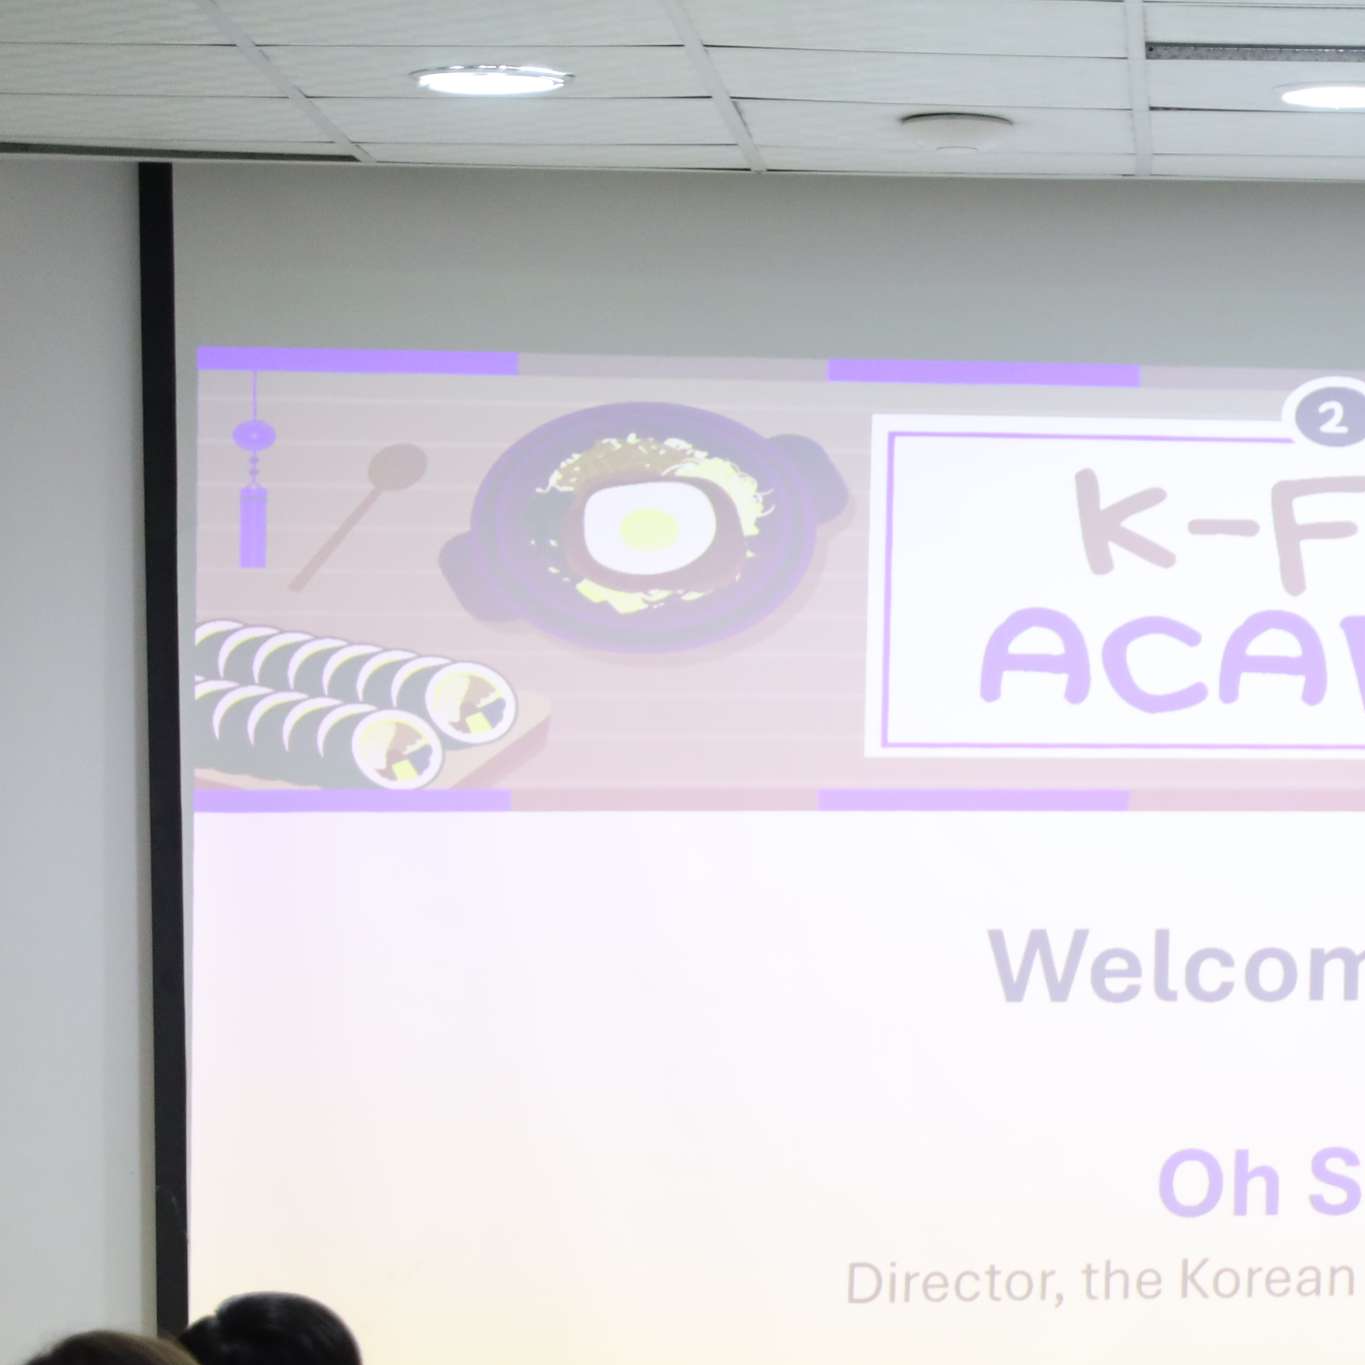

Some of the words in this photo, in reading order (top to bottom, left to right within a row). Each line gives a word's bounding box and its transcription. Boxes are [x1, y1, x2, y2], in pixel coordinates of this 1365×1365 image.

[1157, 1147, 1280, 1219] Oh
[847, 1260, 1065, 1311] Director,
[1079, 1258, 1163, 1302] the
[1179, 1256, 1355, 1300] Korean
